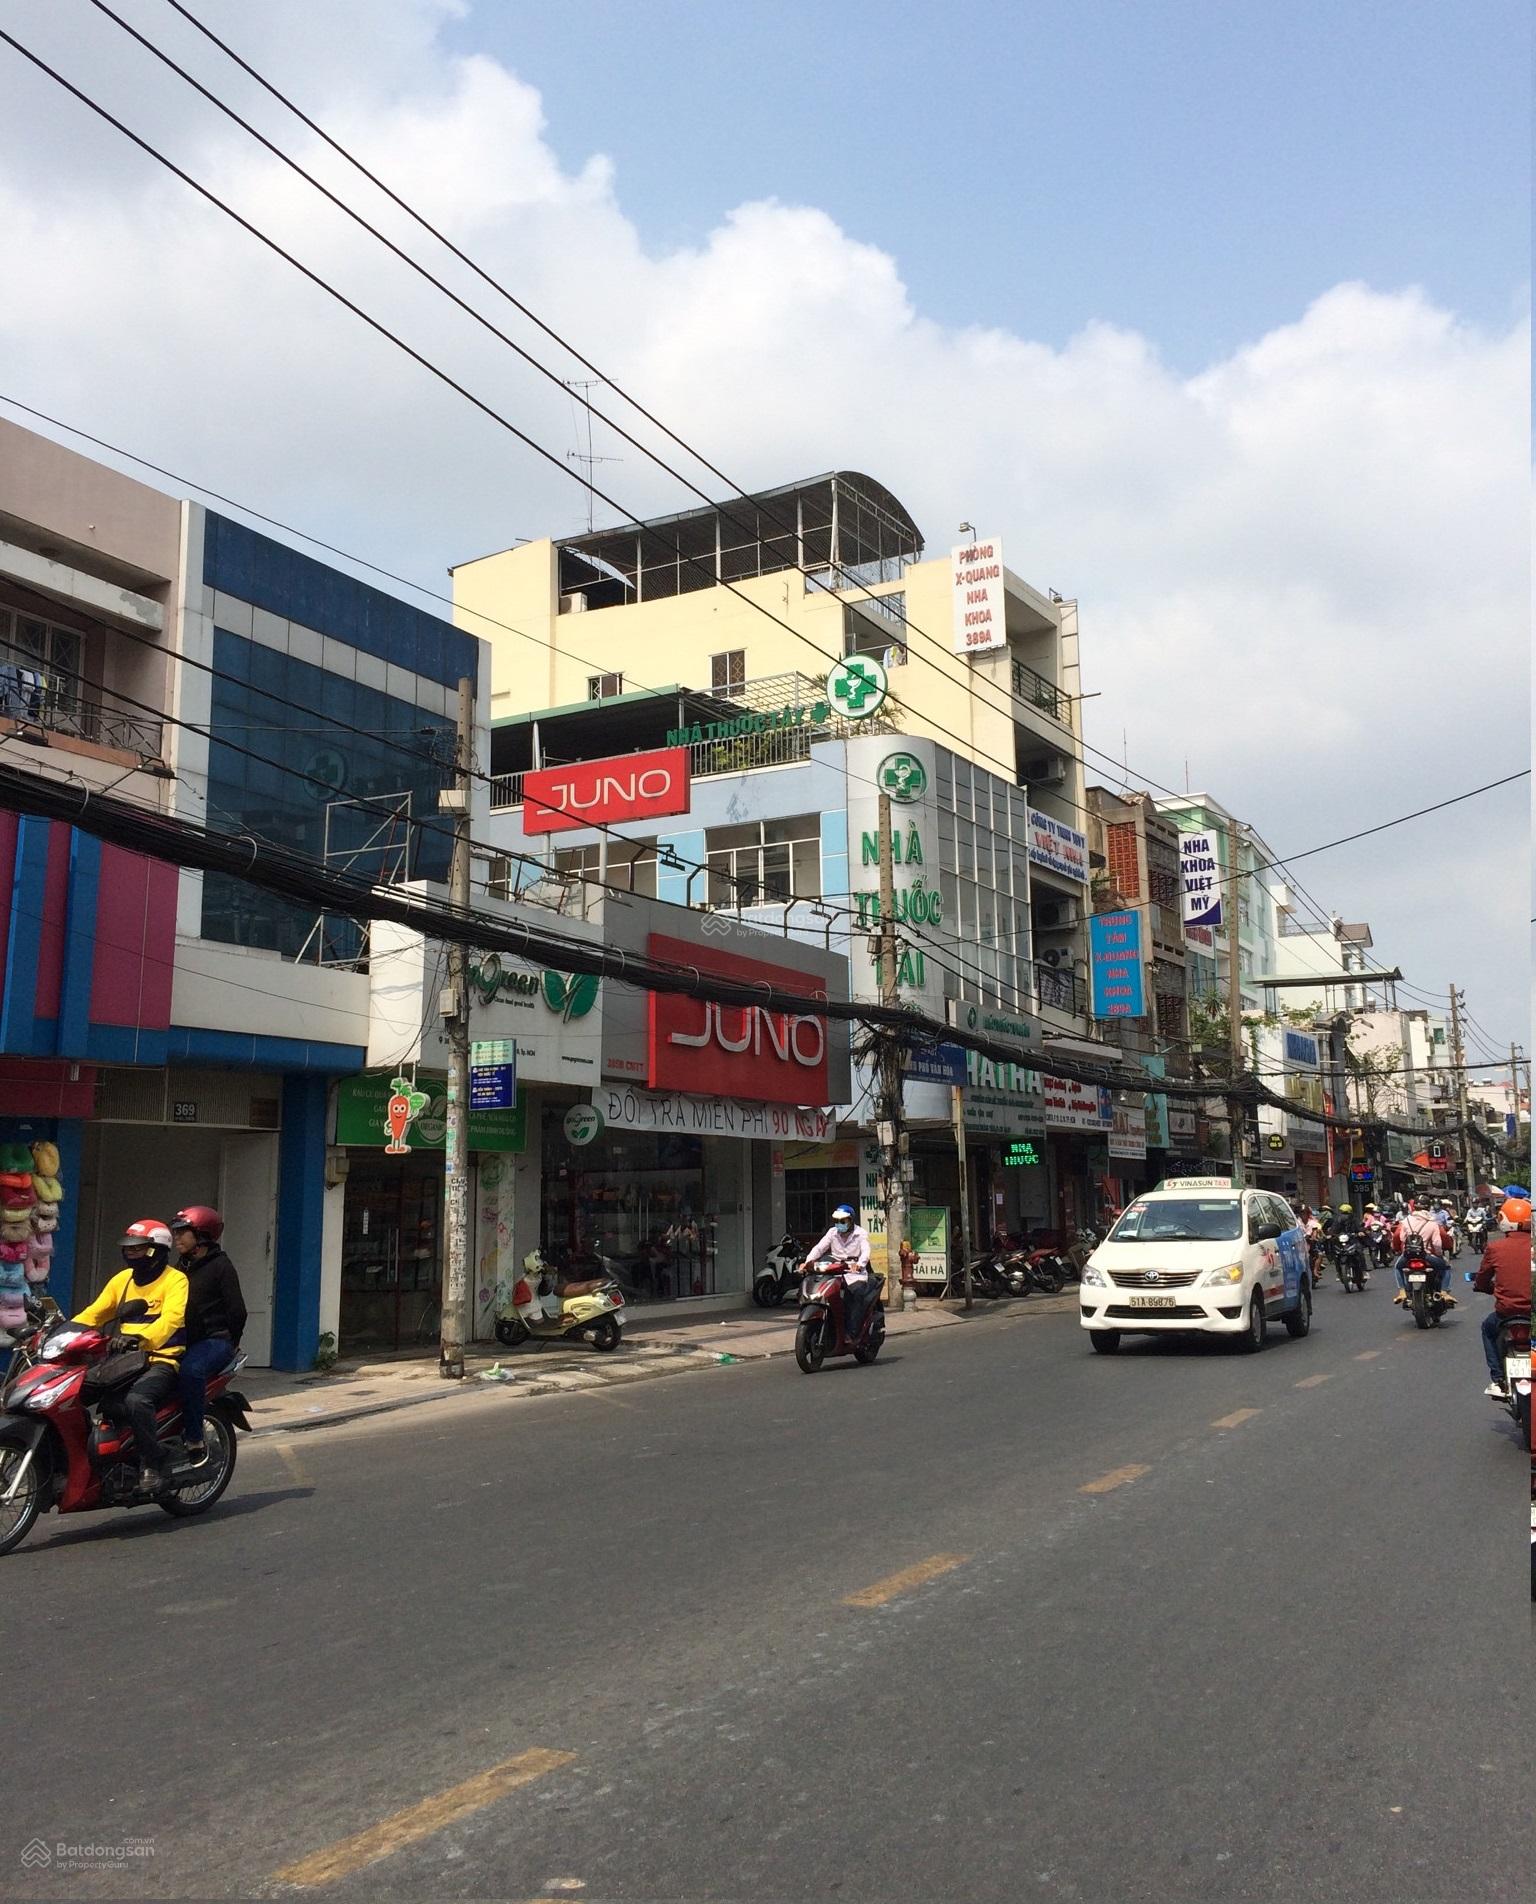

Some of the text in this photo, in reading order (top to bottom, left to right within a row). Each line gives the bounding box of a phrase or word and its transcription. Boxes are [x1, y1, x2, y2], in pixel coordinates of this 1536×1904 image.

[967, 588, 989, 605] NHA
[965, 609, 992, 626] KHOA
[966, 629, 992, 646] 389A
[537, 769, 671, 816] JUNO
[1184, 839, 1210, 854] NHA
[1181, 858, 1216, 873] KHOA
[1185, 875, 1213, 893] VIỆT
[667, 1001, 823, 1066] JUNO
[175, 1103, 196, 1116] 369
[772, 1110, 789, 1136] 90
[931, 1263, 944, 1275] HÀ
